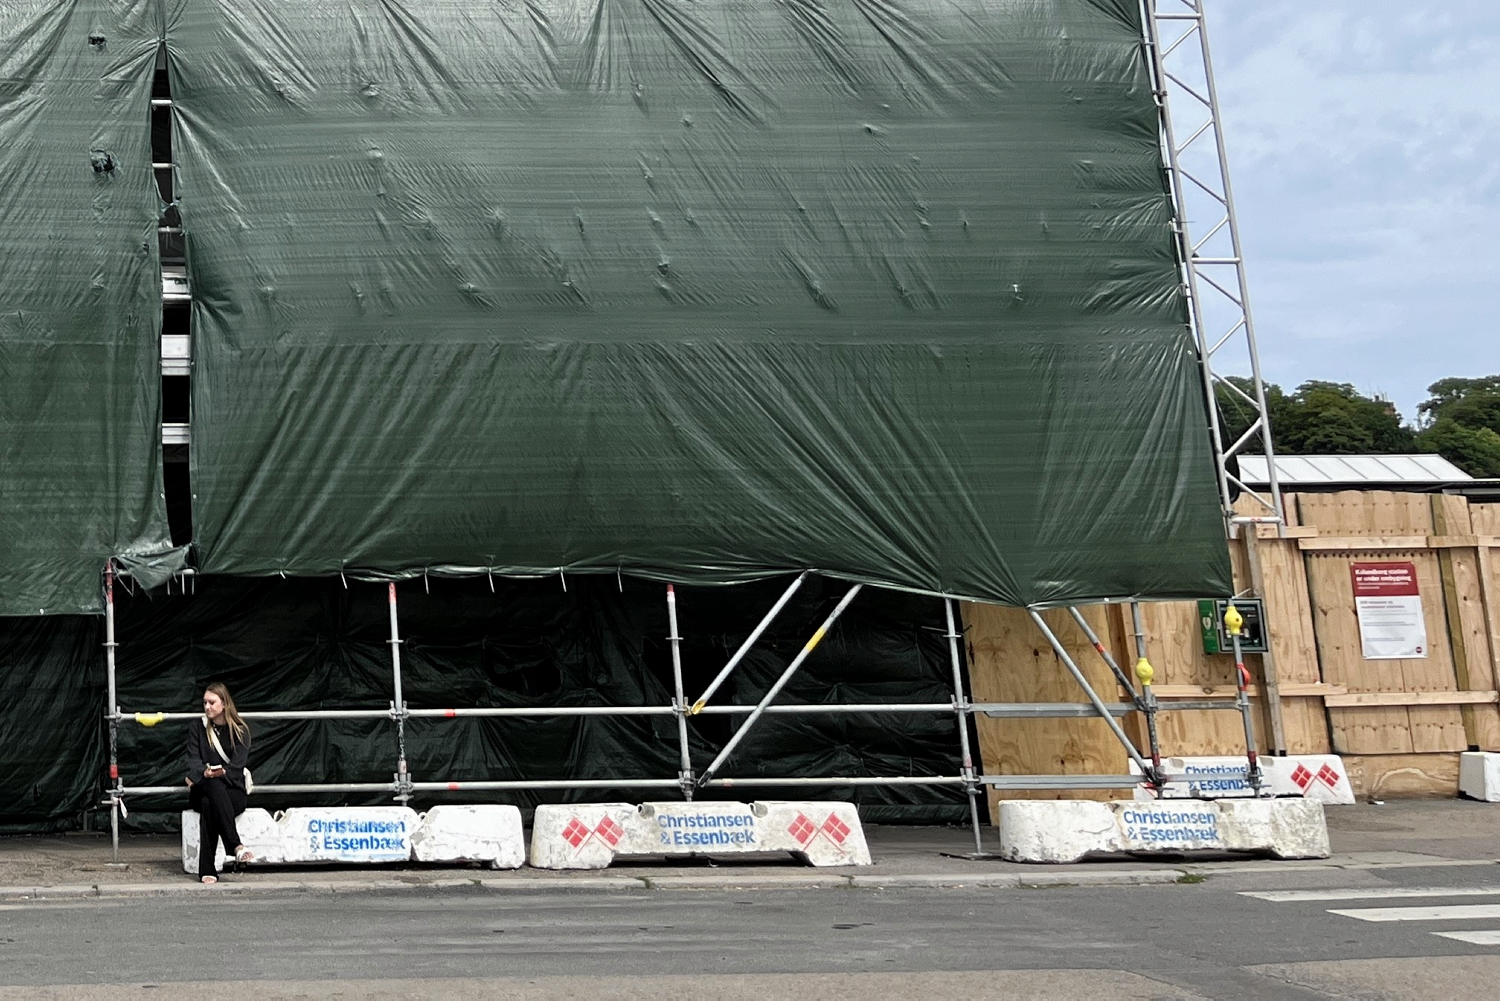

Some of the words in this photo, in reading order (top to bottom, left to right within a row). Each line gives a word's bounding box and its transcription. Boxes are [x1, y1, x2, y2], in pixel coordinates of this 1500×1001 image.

[658, 813, 754, 828] Christiansen
[1124, 811, 1216, 824] Christiansen
[308, 819, 406, 833] Christiansen
[660, 831, 671, 845] &
[673, 830, 756, 845] Essenbæk
[1128, 827, 1138, 840] &
[324, 836, 406, 850] Essenbæk
